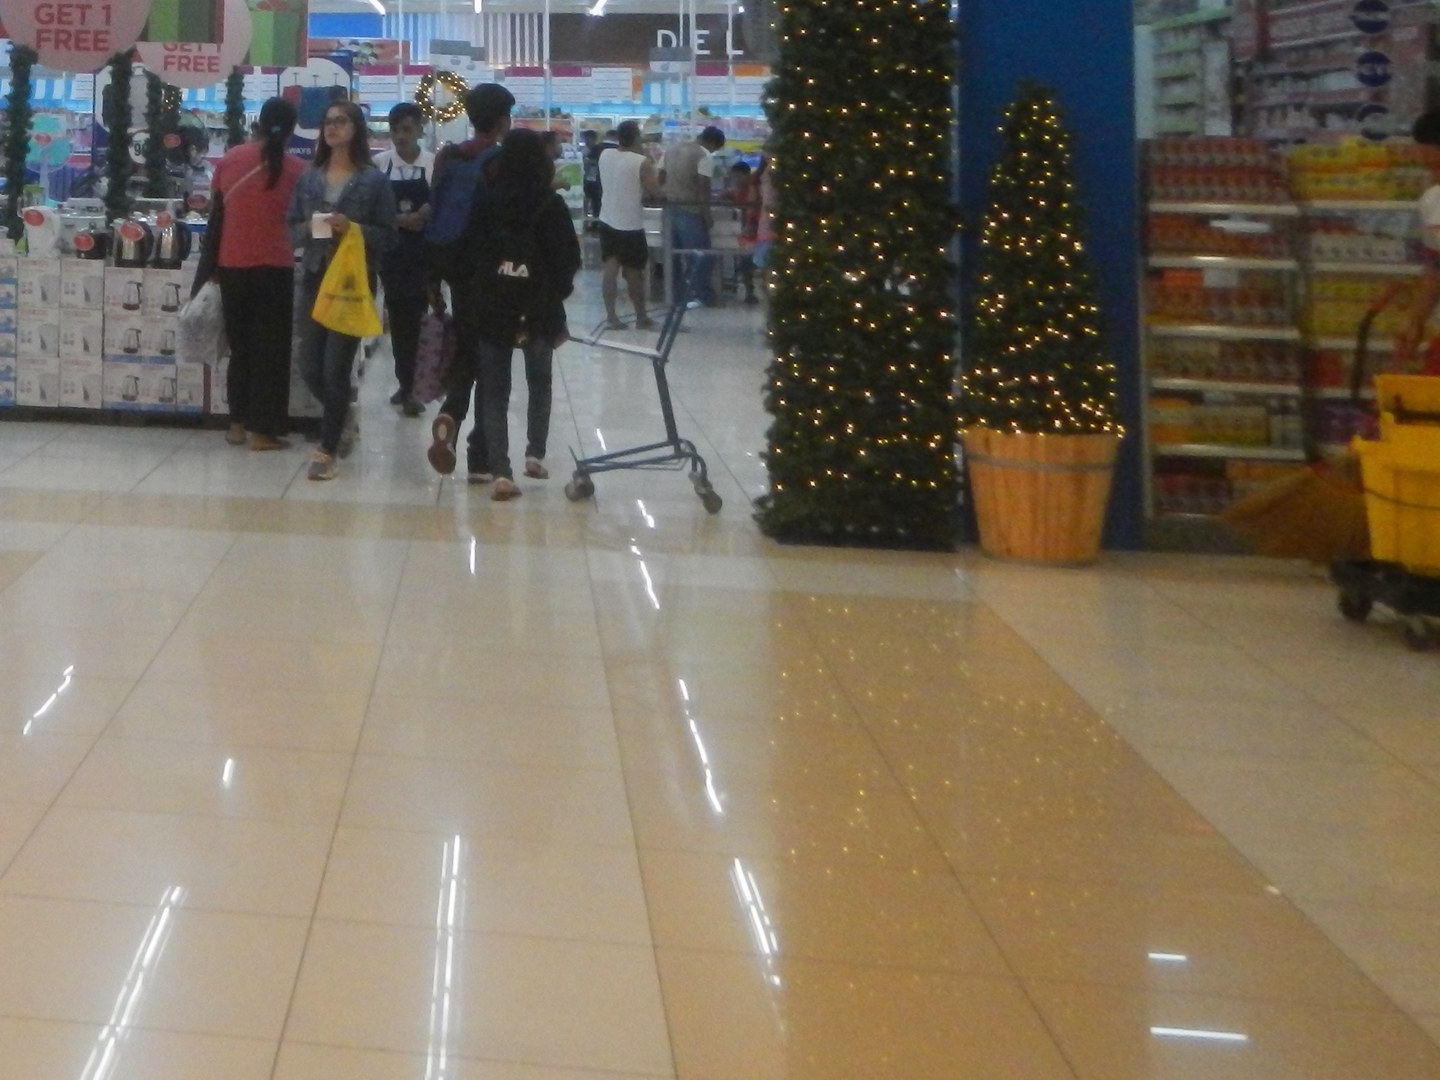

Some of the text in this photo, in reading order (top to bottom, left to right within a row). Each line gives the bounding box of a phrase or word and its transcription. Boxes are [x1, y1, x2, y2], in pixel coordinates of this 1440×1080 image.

[34, 2, 93, 26] GET
[35, 28, 111, 52] FREE
[163, 55, 221, 73] FREE
